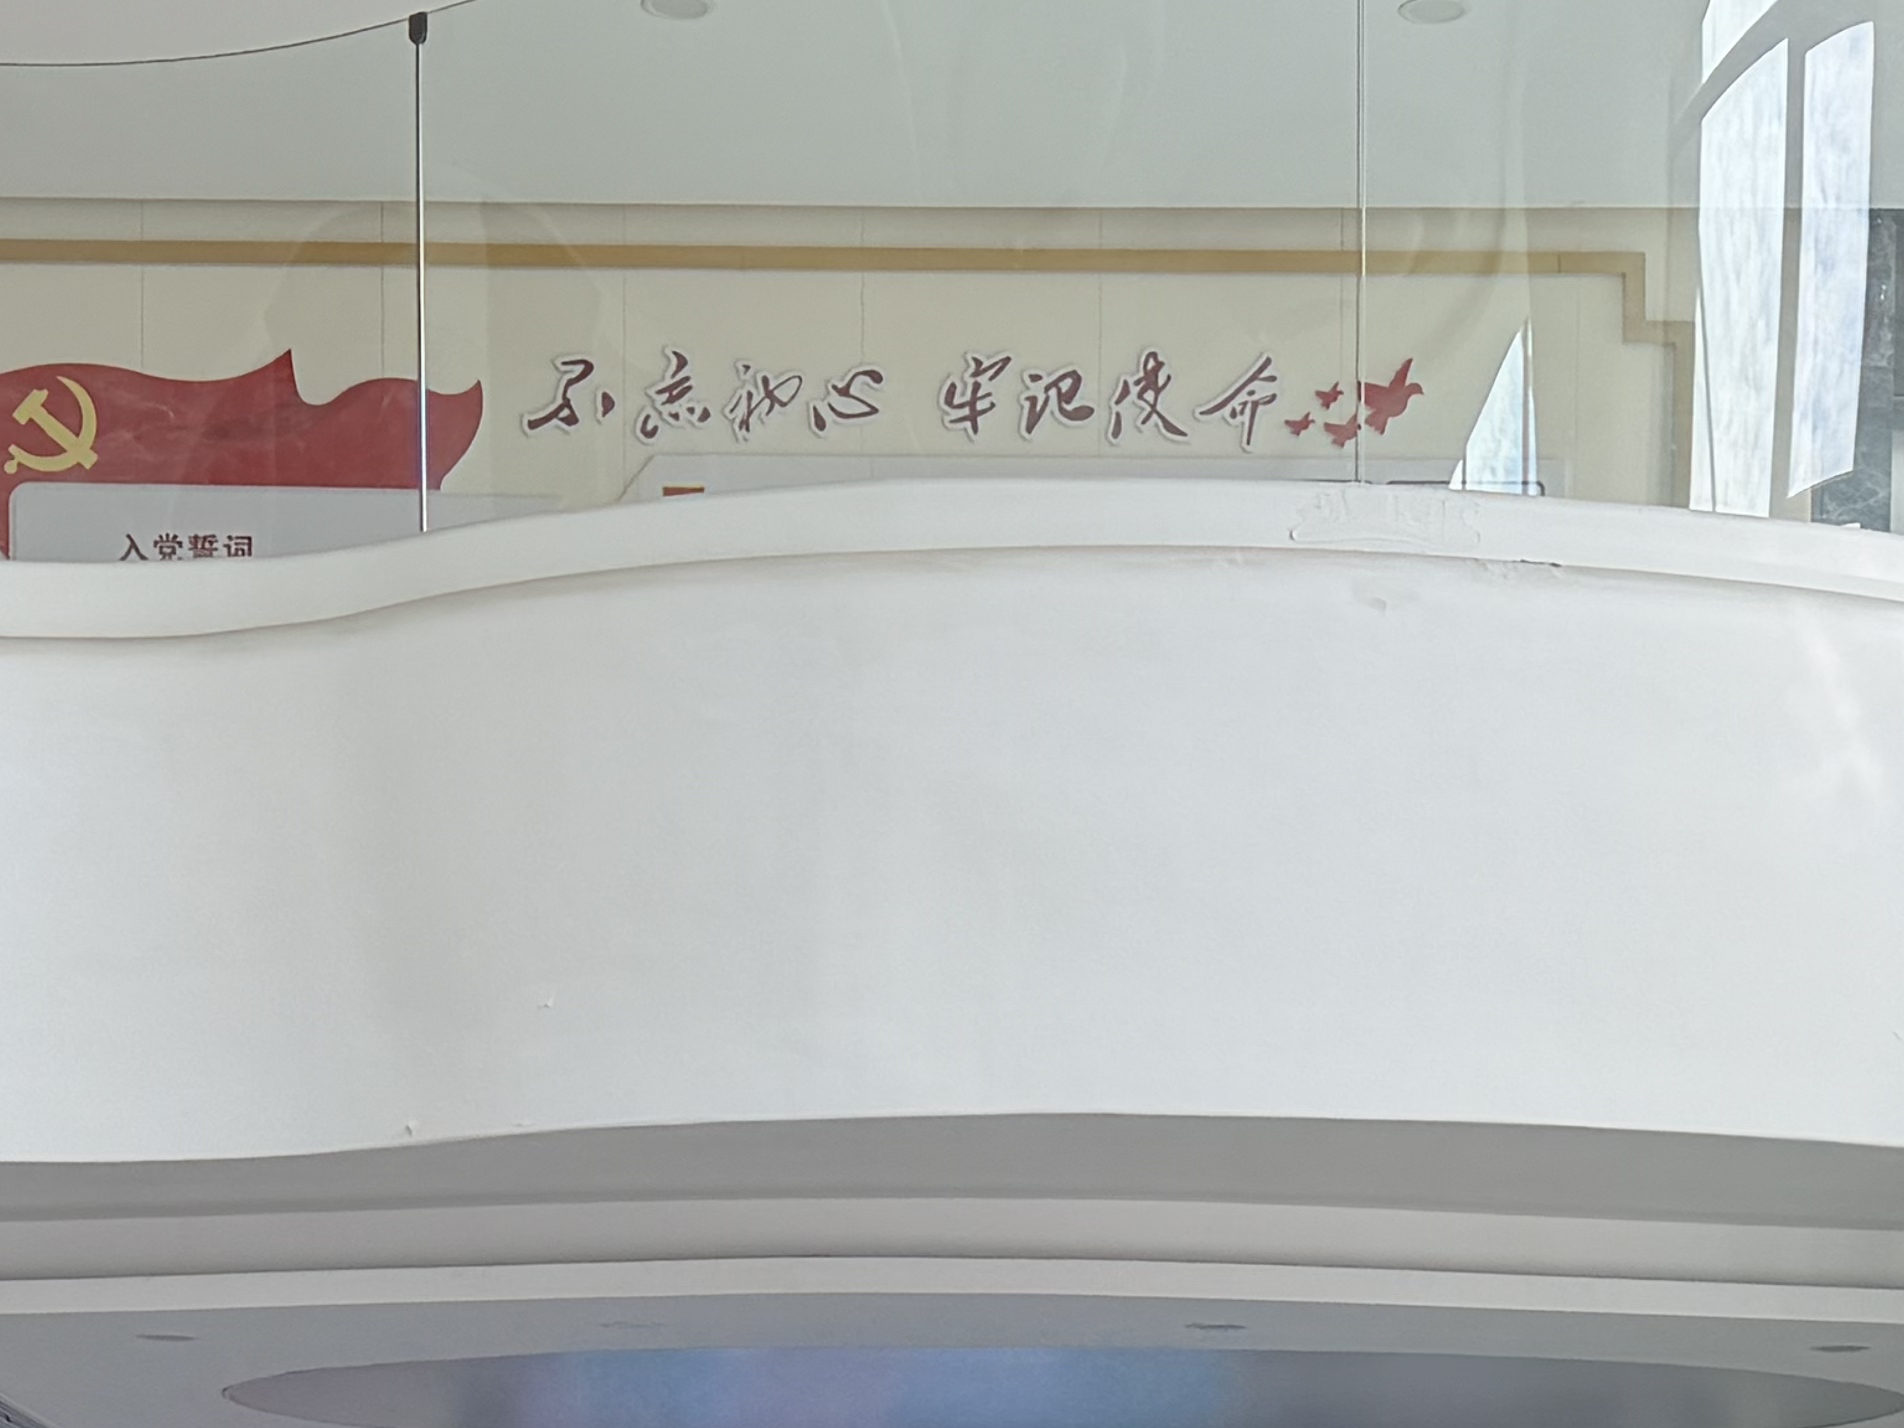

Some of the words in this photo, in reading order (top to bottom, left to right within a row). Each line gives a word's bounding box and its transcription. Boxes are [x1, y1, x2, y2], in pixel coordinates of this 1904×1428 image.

[526, 352, 886, 440] 不忘初心
[939, 350, 1286, 446] 牢记使命
[119, 532, 253, 562] 入党誓词
